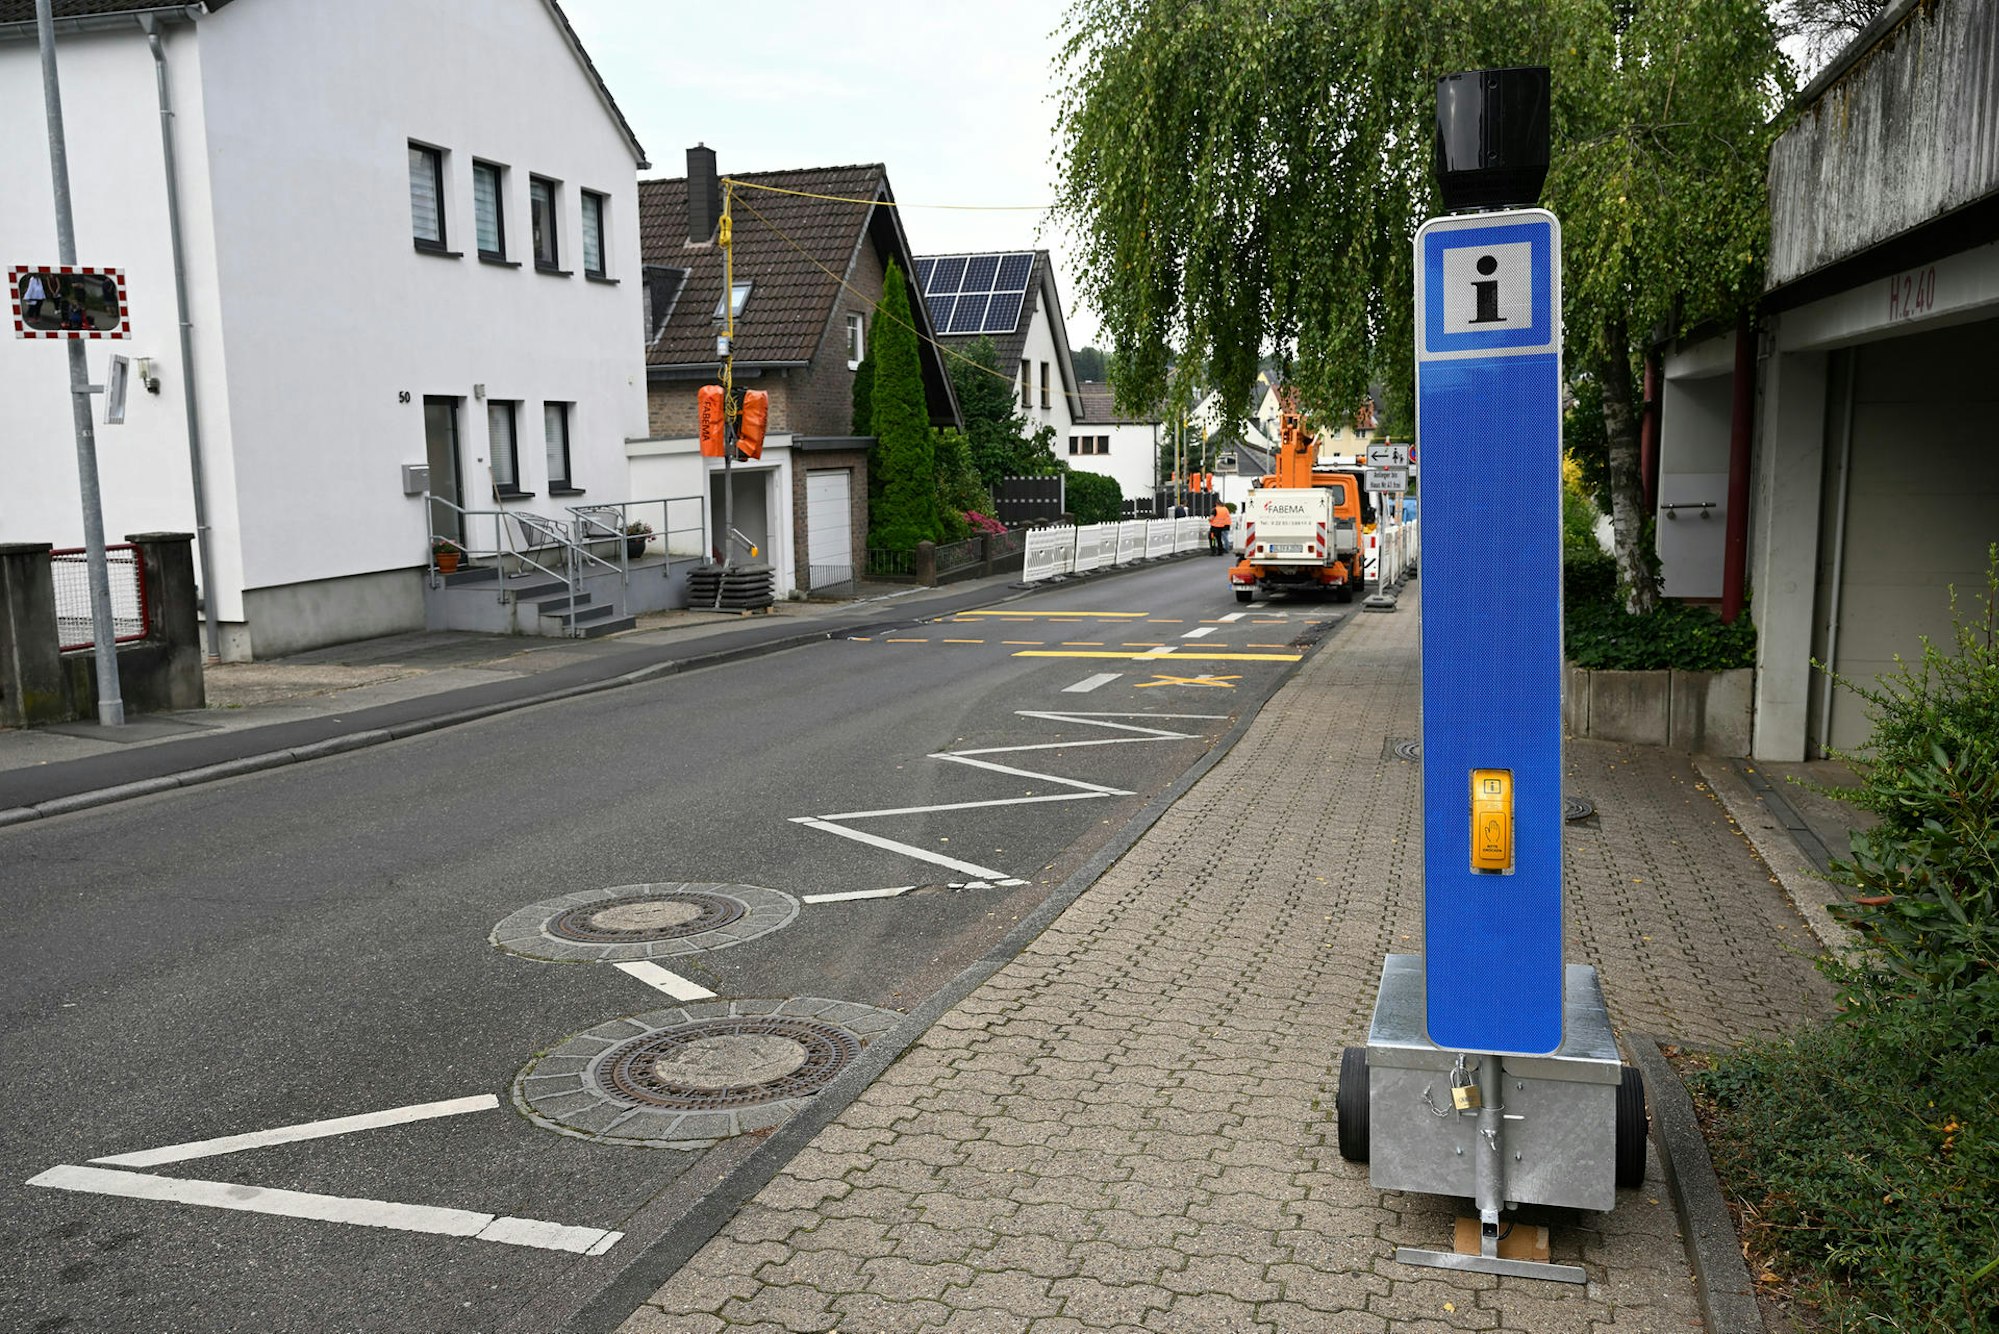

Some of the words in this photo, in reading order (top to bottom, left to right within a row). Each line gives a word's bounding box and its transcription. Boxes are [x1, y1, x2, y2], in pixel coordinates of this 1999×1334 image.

[1468, 255, 1507, 324] i
[399, 391, 411, 404] 50
[701, 401, 712, 441] FABEMA
[1268, 505, 1305, 514] FABEMA
